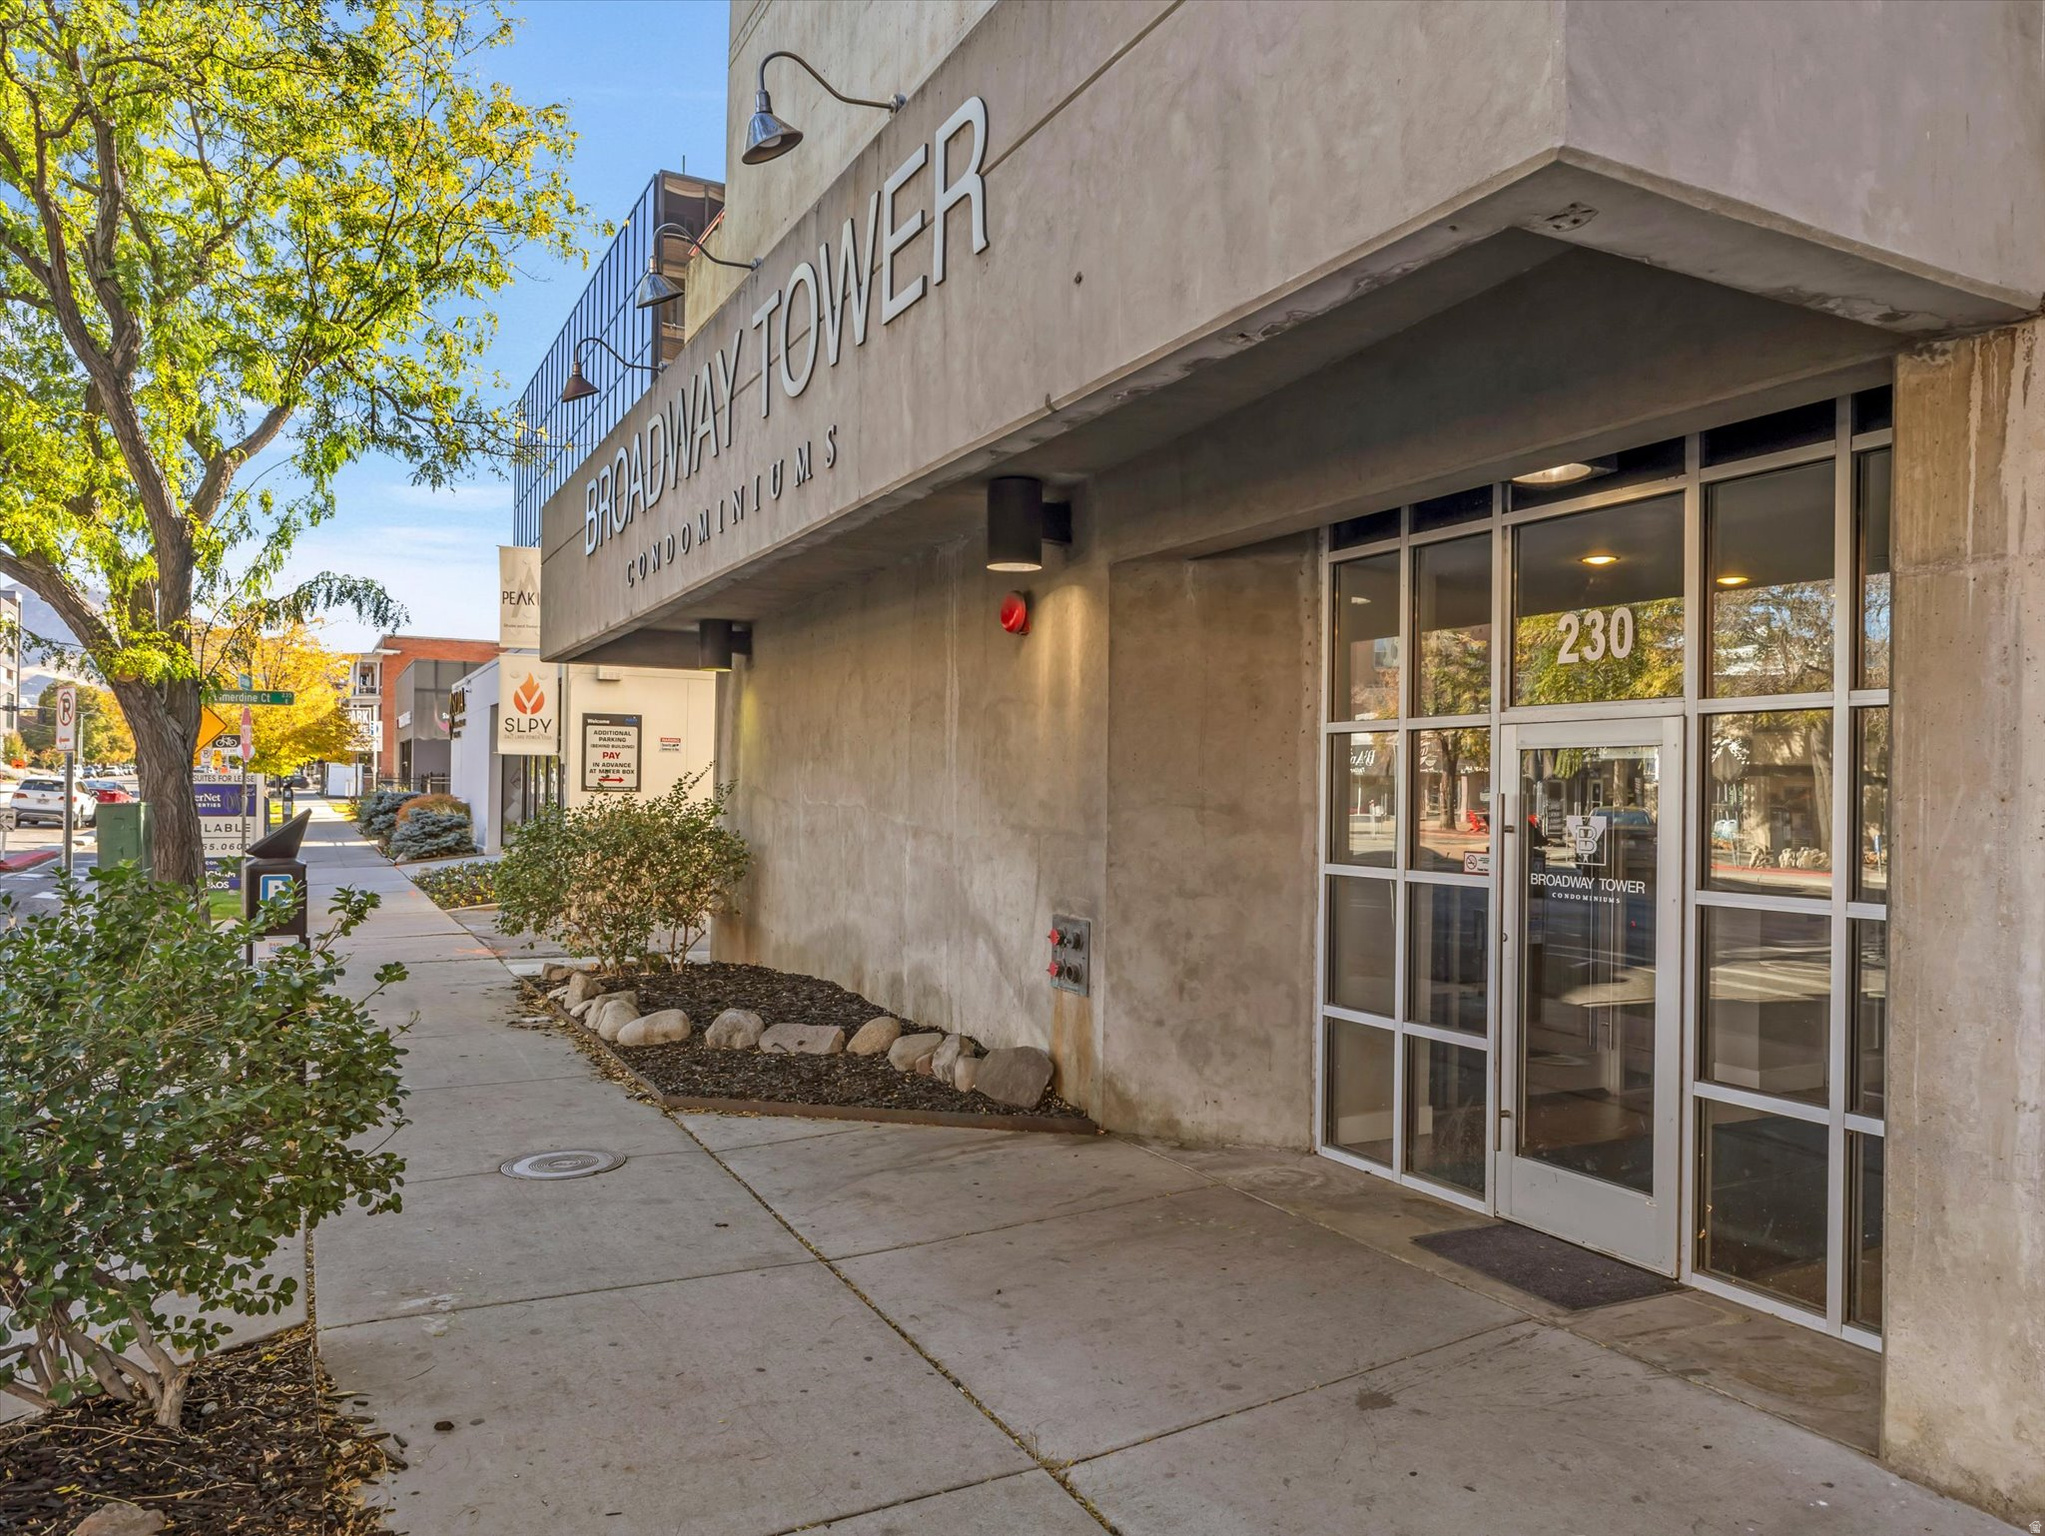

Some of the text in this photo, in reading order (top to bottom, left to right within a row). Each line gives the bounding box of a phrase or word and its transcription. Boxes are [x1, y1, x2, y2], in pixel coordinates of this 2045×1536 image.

[585, 96, 990, 556] BROADWAY TOWER
[627, 424, 838, 587] CONDOMINIUMS
[502, 590, 535, 606] PEAK
[1557, 607, 1634, 664] 230
[261, 693, 271, 703] Ct
[504, 717, 552, 733] SLPY
[602, 751, 621, 759] PAY
[193, 774, 216, 782] SUITES
[195, 793, 221, 802] erNet
[202, 824, 251, 832] LABLE
[1530, 873, 1646, 894] BROADWAY TOWER
[1552, 892, 1621, 904] CONDOMINIUMS
